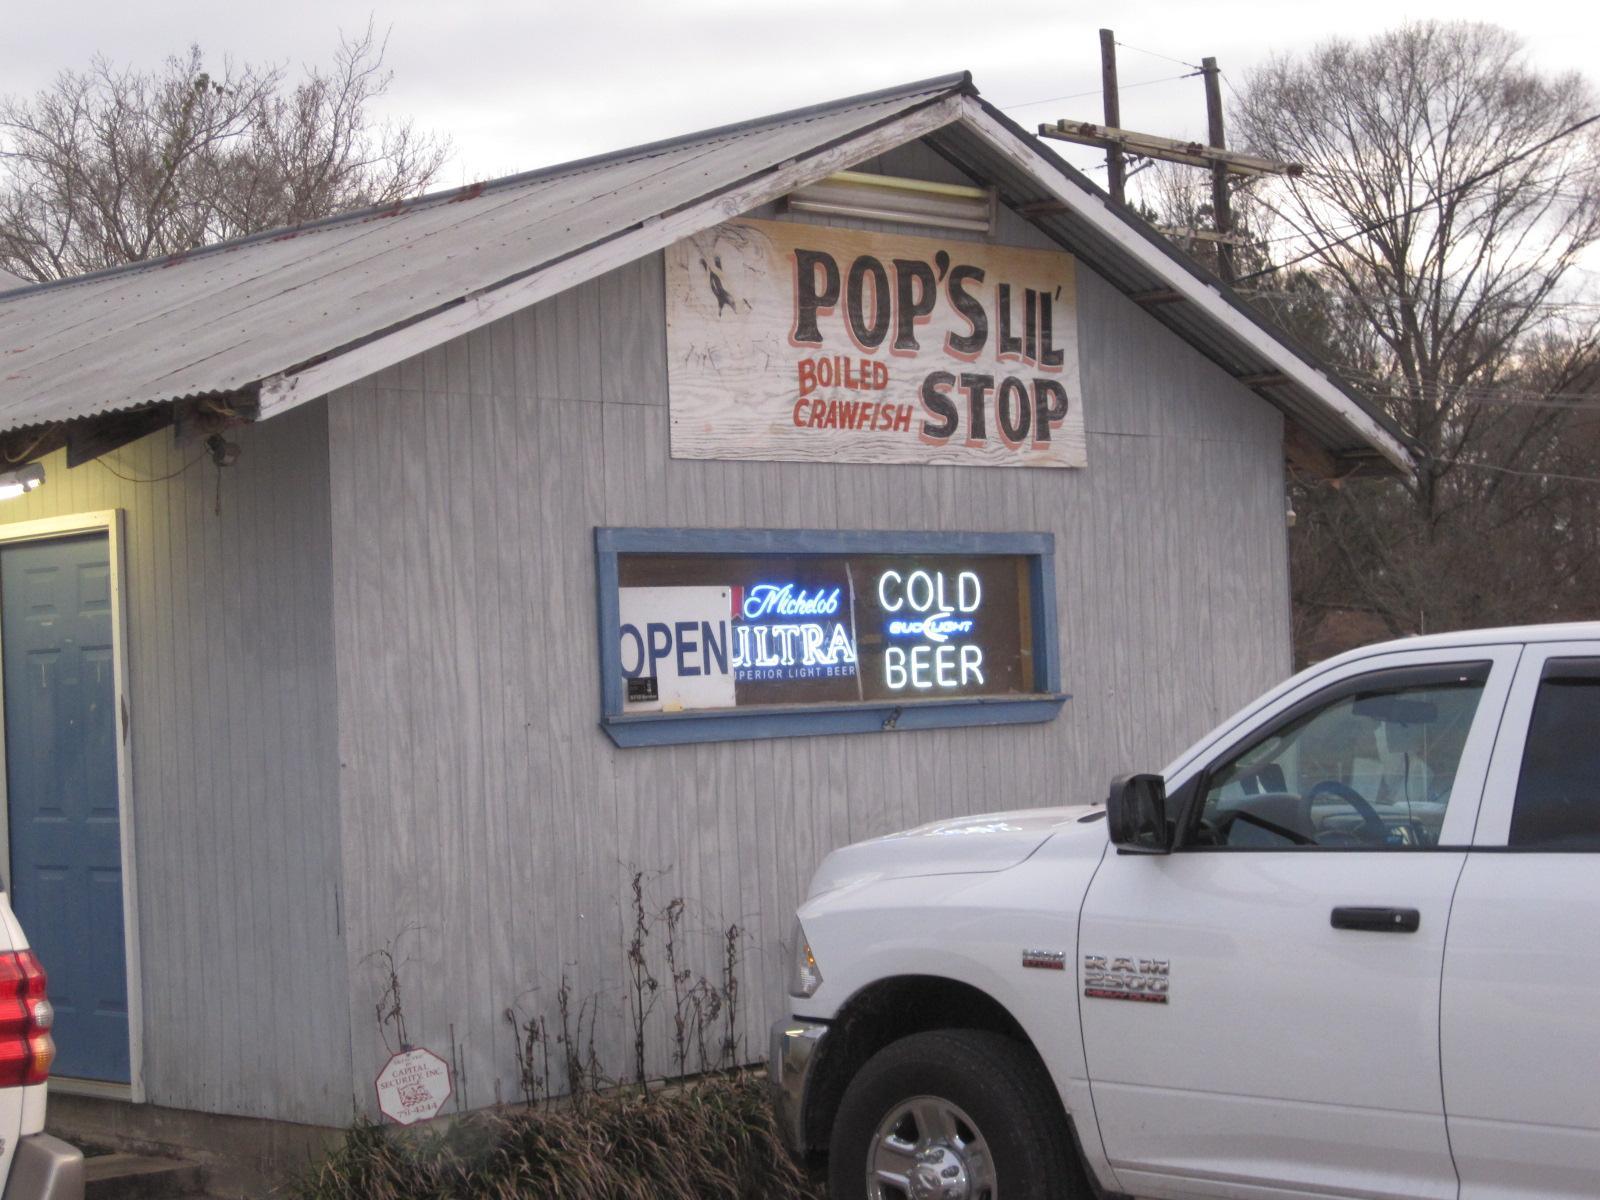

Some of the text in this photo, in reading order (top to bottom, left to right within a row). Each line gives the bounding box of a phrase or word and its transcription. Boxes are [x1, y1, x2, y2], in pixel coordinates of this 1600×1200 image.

[788, 248, 1065, 373] POP'S LIL'
[798, 356, 889, 397] BOILED
[793, 398, 915, 433] CRAWFISH
[919, 371, 1069, 451] STOP
[743, 583, 841, 619] Michelob
[878, 570, 982, 612] COLD
[619, 620, 729, 680] OPEN
[885, 645, 984, 689] BEER
[788, 667, 822, 679] LIGHT
[827, 666, 856, 677] BEER
[1084, 971, 1169, 992] 2500
[1085, 955, 1170, 975] RAM
[391, 1063, 430, 1078] CAPITAL
